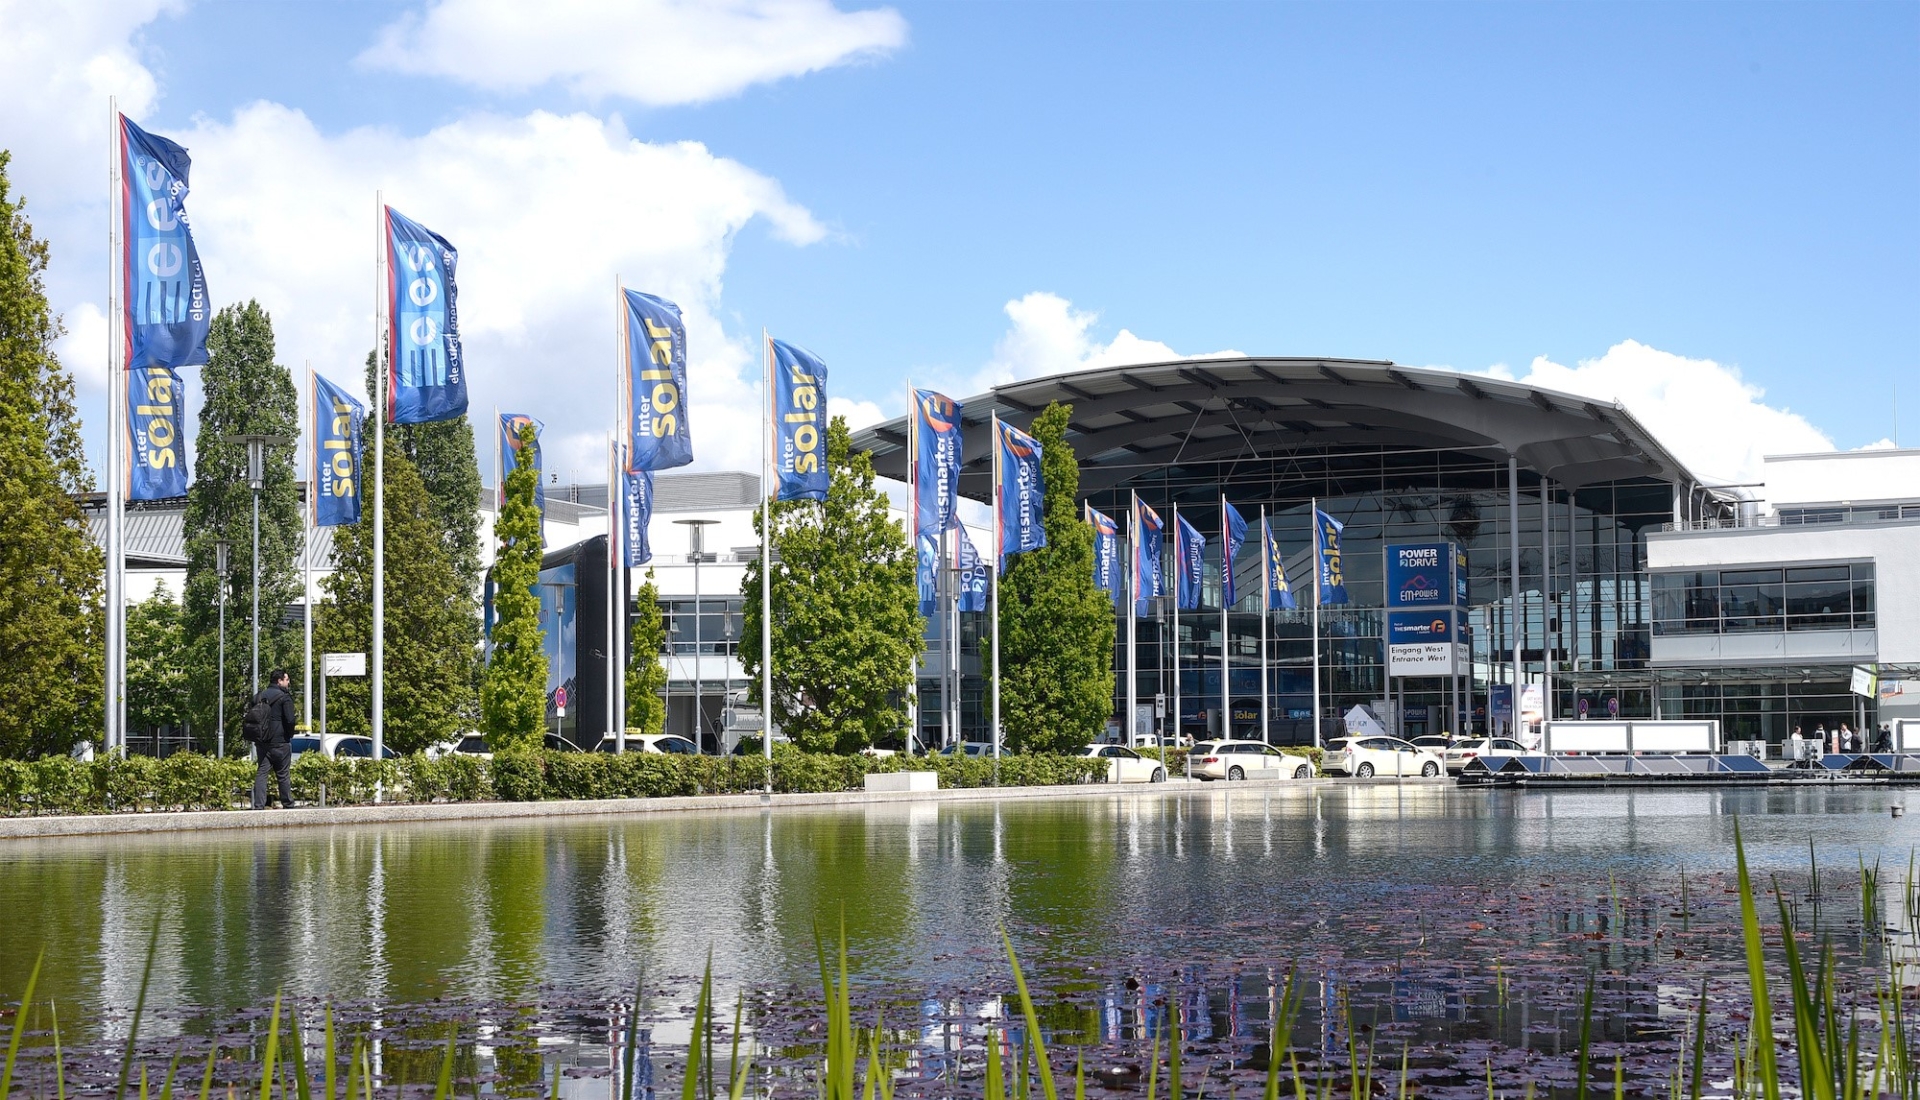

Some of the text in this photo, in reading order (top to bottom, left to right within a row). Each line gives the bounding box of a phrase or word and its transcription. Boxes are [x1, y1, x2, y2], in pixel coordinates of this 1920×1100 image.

[408, 245, 438, 347] ees
[641, 318, 679, 439] solar
[637, 395, 650, 437] inter
[784, 366, 819, 474] solar
[137, 428, 148, 468] inter
[324, 396, 355, 498] solar
[782, 436, 794, 473] inter
[321, 461, 332, 497] inter
[1323, 522, 1341, 587] solar
[1399, 548, 1438, 559] POWER
[1322, 562, 1330, 586] inter
[1391, 645, 1444, 655] Eingang West
[1391, 655, 1424, 663] Entrance
[1234, 710, 1258, 720] solar
